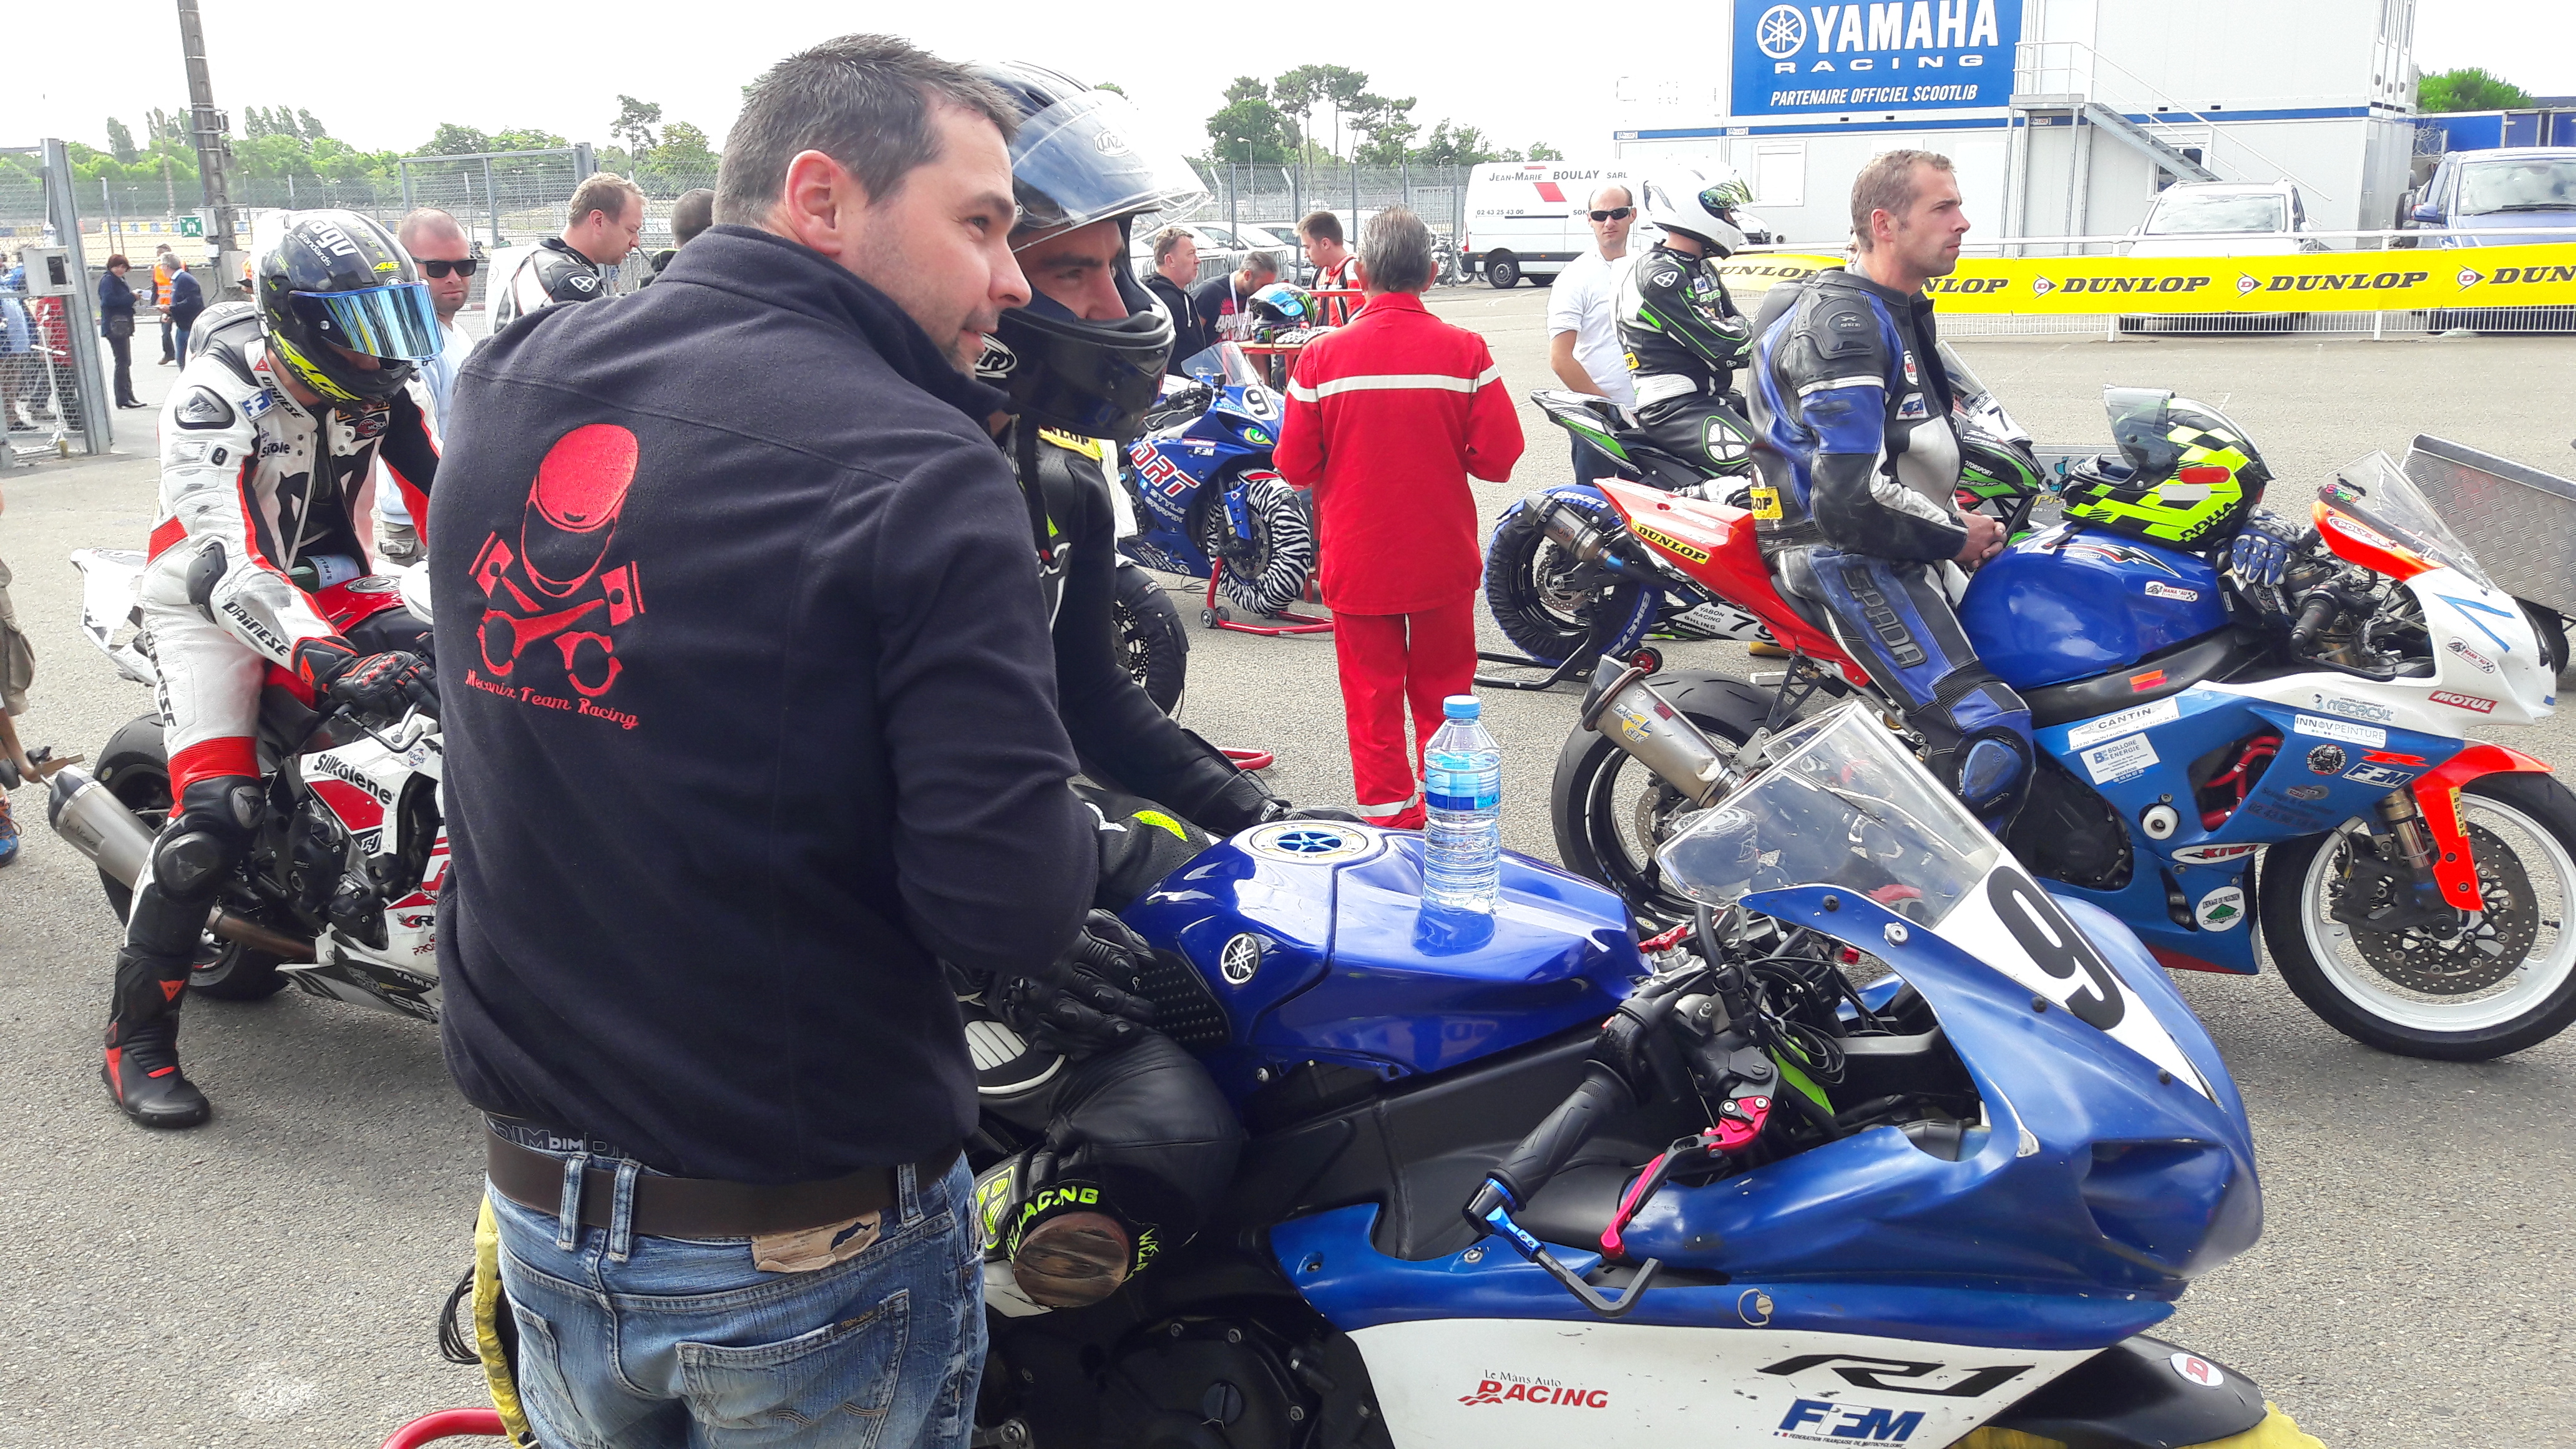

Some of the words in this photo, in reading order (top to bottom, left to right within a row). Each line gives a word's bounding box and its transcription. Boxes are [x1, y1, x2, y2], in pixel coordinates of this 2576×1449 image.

[1810, 1, 1999, 53] YAMAHA
[1774, 54, 1984, 74] RACING
[1770, 88, 1848, 107] PARTENAIRE
[1850, 86, 1909, 103] OFFICIEL
[1912, 84, 1979, 102] SCOOTLIB
[1553, 170, 1600, 180] BOULAY
[296, 232, 334, 266] standards
[2060, 277, 2210, 293] DUNLOP
[2266, 271, 2428, 293] DUNLOP
[1246, 389, 1270, 416] 9
[1637, 525, 1707, 561] DUNLOP
[1692, 611, 1722, 623] RACING
[1699, 605, 1725, 618] YABON
[1675, 622, 1711, 637] Kawasaki
[520, 686, 572, 711] Team
[577, 697, 640, 731] Racing
[2432, 691, 2492, 711] MOTUL
[2098, 707, 2152, 729] CANTIN
[1624, 727, 1649, 744] SBK
[407, 750, 427, 764] FUCHS
[313, 753, 393, 805] Silkolene
[2452, 797, 2466, 836] DUNLOP
[2202, 844, 2258, 859] KIWI
[1986, 865, 2126, 1032] 9
[549, 1136, 584, 1151] DIM
[1485, 1369, 1496, 1380] Le
[1500, 1371, 1531, 1384] Mans
[1535, 1376, 1561, 1387] Auto
[1457, 1380, 1609, 1408] RACING
[1788, 1433, 1822, 1442] FEDERATION
